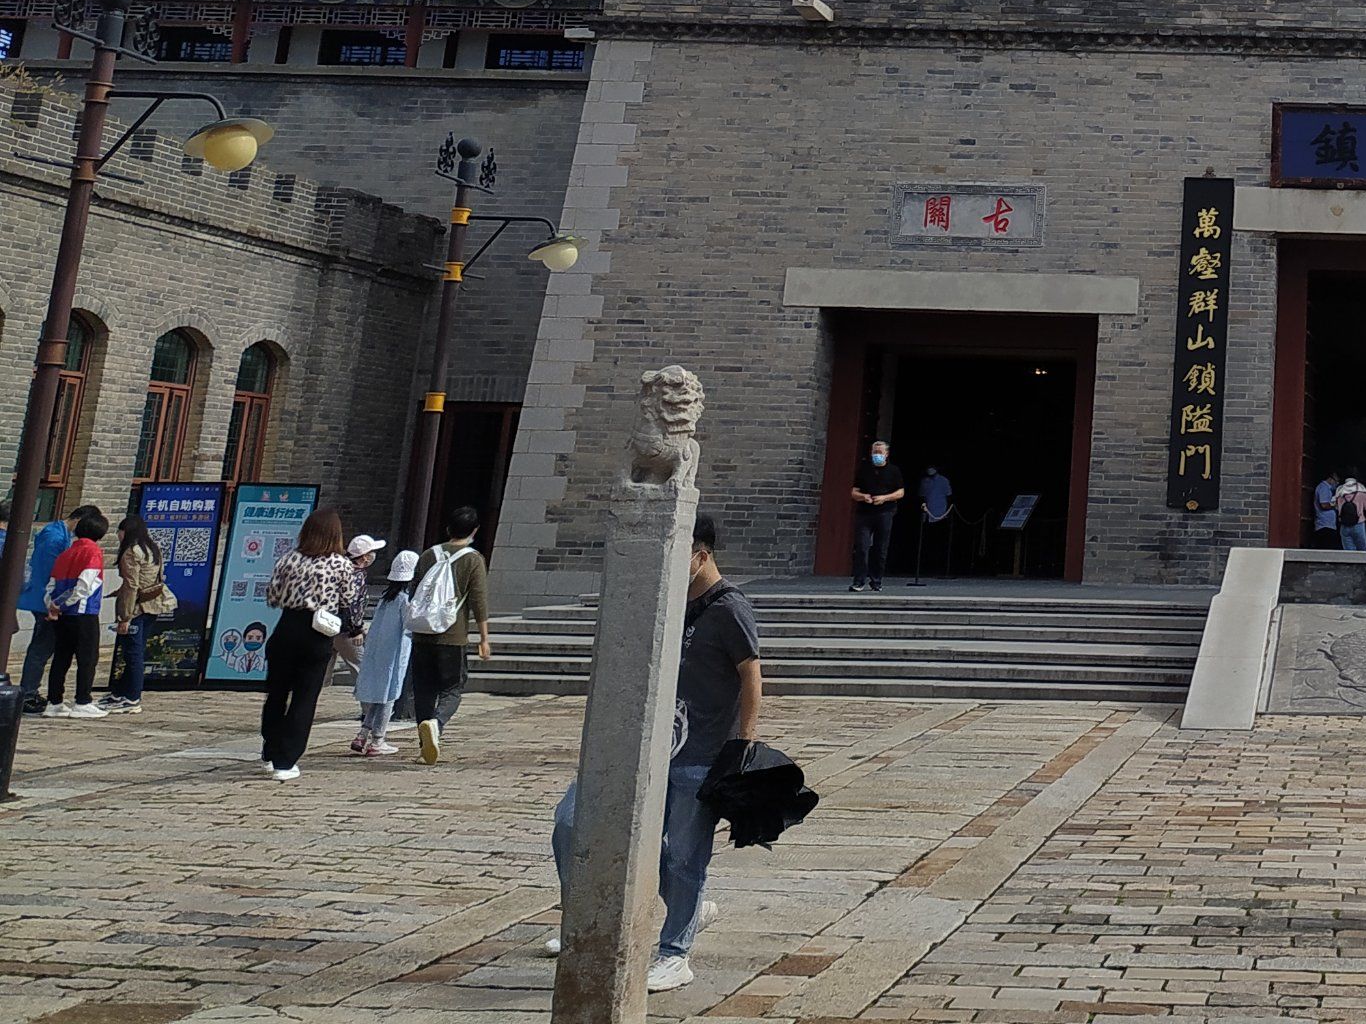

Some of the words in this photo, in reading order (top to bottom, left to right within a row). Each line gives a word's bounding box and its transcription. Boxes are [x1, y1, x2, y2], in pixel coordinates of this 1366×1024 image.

[145, 499, 216, 511] 手机自助购票
[244, 506, 307, 518] 健康通行检查
